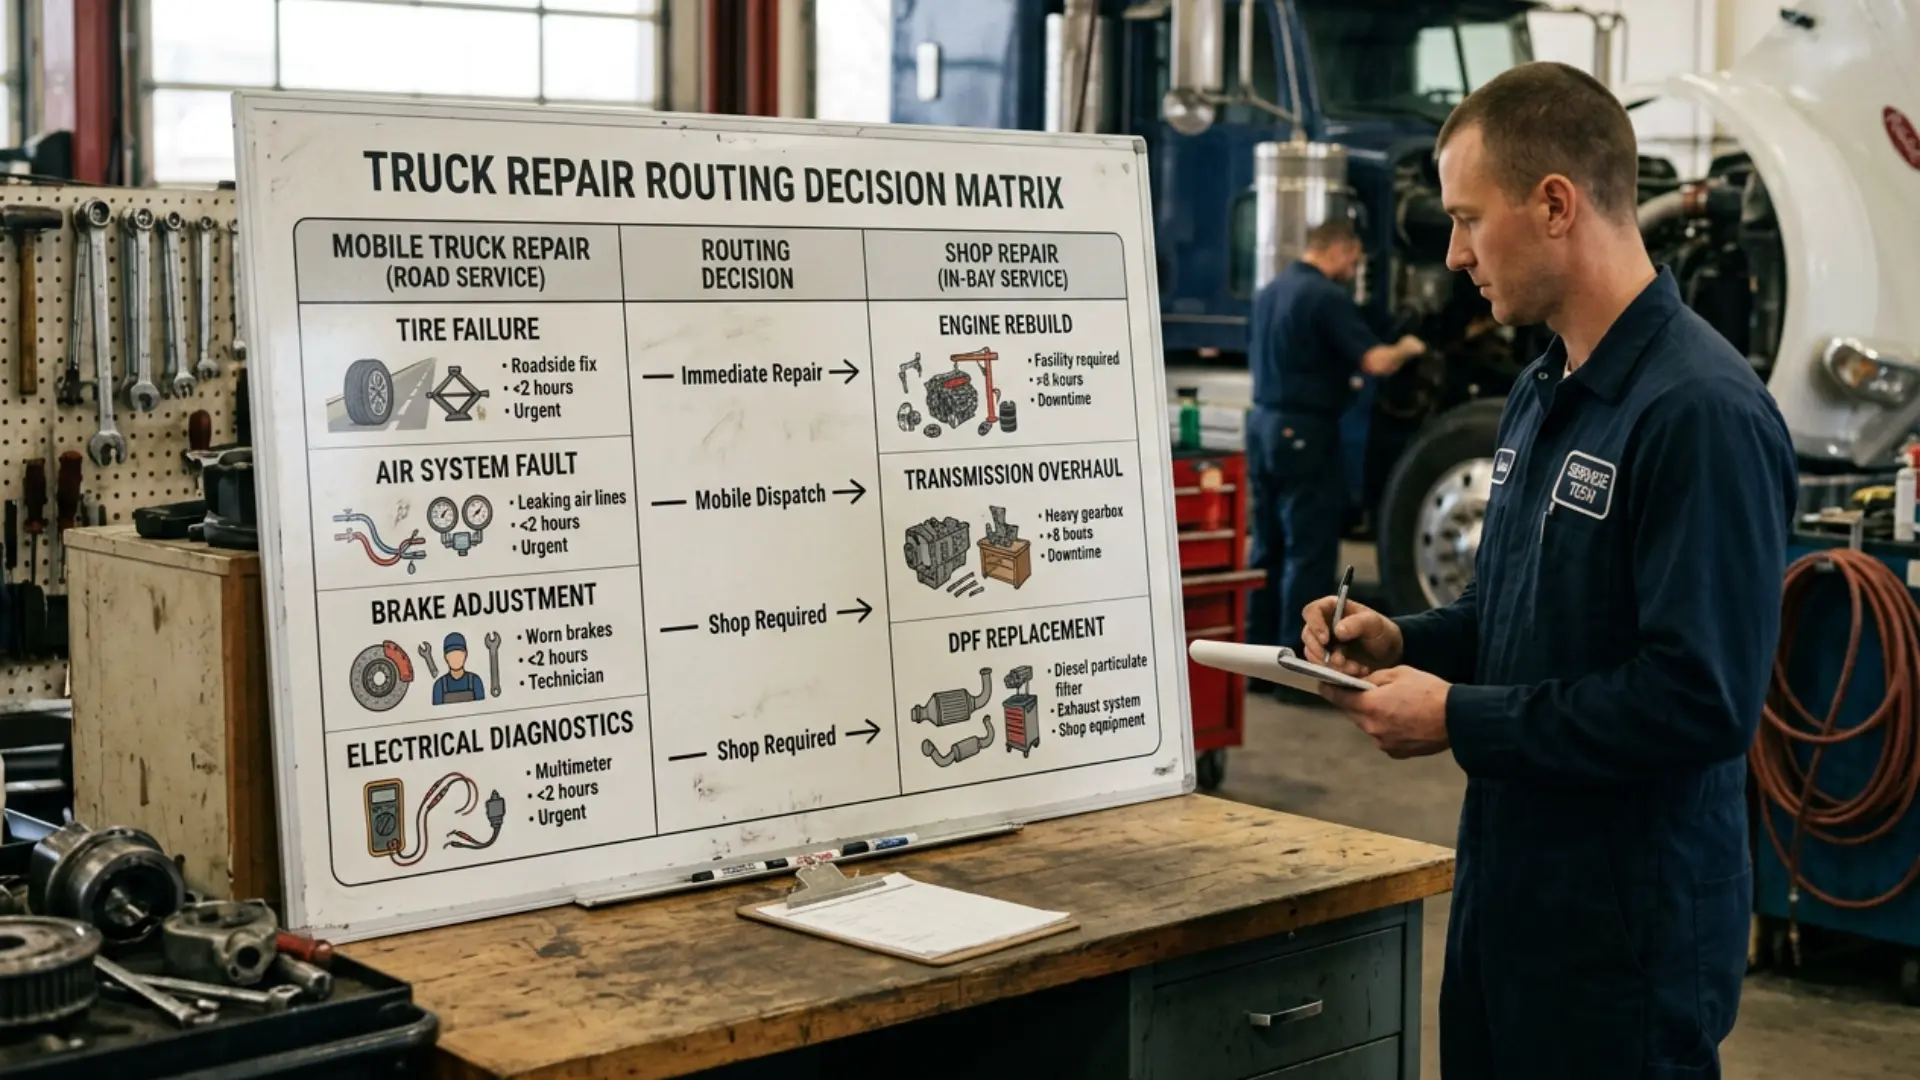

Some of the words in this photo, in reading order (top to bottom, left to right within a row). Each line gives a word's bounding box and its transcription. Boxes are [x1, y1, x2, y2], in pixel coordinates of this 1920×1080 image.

[363, 151, 497, 194] TRUCK
[507, 156, 635, 198] REPAIR
[646, 161, 794, 202] ROUTING
[804, 168, 946, 206] DECISION
[955, 173, 1064, 209] MATRIX
[333, 234, 423, 258] MOBILE
[429, 235, 506, 259] TRUCK
[513, 236, 590, 260] REPAIR
[702, 239, 790, 261] ROUTING
[946, 243, 992, 263] SHOP
[998, 243, 1058, 263] REPAIR
[387, 265, 449, 292] (ROAD
[456, 266, 545, 292] SERVICE)
[702, 267, 793, 289] DECISION
[938, 268, 995, 292] (IN-BAY
[1001, 269, 1068, 291] SERVICE)
[396, 318, 447, 341] TIRE
[453, 317, 540, 341] FAILURE
[940, 315, 1000, 335] ENGINE
[1005, 314, 1072, 334] REBUILD
[512, 356, 575, 373] Roadside
[579, 355, 597, 371] fix
[1076, 351, 1120, 369] required
[682, 363, 767, 385] Immediate
[773, 363, 822, 387] Repair
[513, 380, 530, 395] <2
[534, 380, 573, 395] hours
[1038, 392, 1091, 407] Downtime
[515, 403, 561, 422] Urgent
[376, 460, 414, 484] AIR
[421, 455, 509, 482] SYSTEM
[516, 452, 577, 476] FAULT
[904, 463, 1033, 490] TRANSMISSION
[1039, 458, 1123, 482] OVERHAUL
[518, 492, 571, 511] Leaking
[575, 491, 592, 507] air
[595, 489, 626, 505] lines
[696, 487, 751, 510] Mobile
[756, 483, 825, 510] Dispatch
[520, 516, 537, 532] <2
[541, 515, 580, 531] hours
[1045, 508, 1078, 524] Heavy
[1081, 504, 1123, 523] gearbox
[521, 538, 568, 558] Urgent
[1048, 546, 1101, 562] Downtime
[372, 595, 446, 624] BRAKE
[453, 582, 596, 617] ADJUSTMENT
[709, 613, 750, 637] Shop
[755, 603, 826, 632] Required
[526, 628, 562, 644] Worn
[566, 622, 612, 640] brakes
[949, 630, 981, 653] DPF
[986, 616, 1104, 649] REPLACEMENT
[528, 650, 544, 666] <2
[549, 649, 588, 665] hours
[1055, 659, 1088, 677] Diesel
[1091, 654, 1147, 676] particulate
[528, 668, 603, 690] Technician
[1057, 699, 1100, 717] Exhaust
[1103, 696, 1140, 713] system
[347, 729, 484, 768] ELECTRICAL
[490, 710, 633, 750] DIAGNOSTICS
[1059, 722, 1086, 738] Shop
[718, 739, 759, 762] Shop
[764, 724, 836, 756] Required
[536, 757, 612, 779] Multimeter
[537, 785, 555, 801] <2
[559, 782, 599, 799] hours
[538, 804, 586, 827] Urgent
